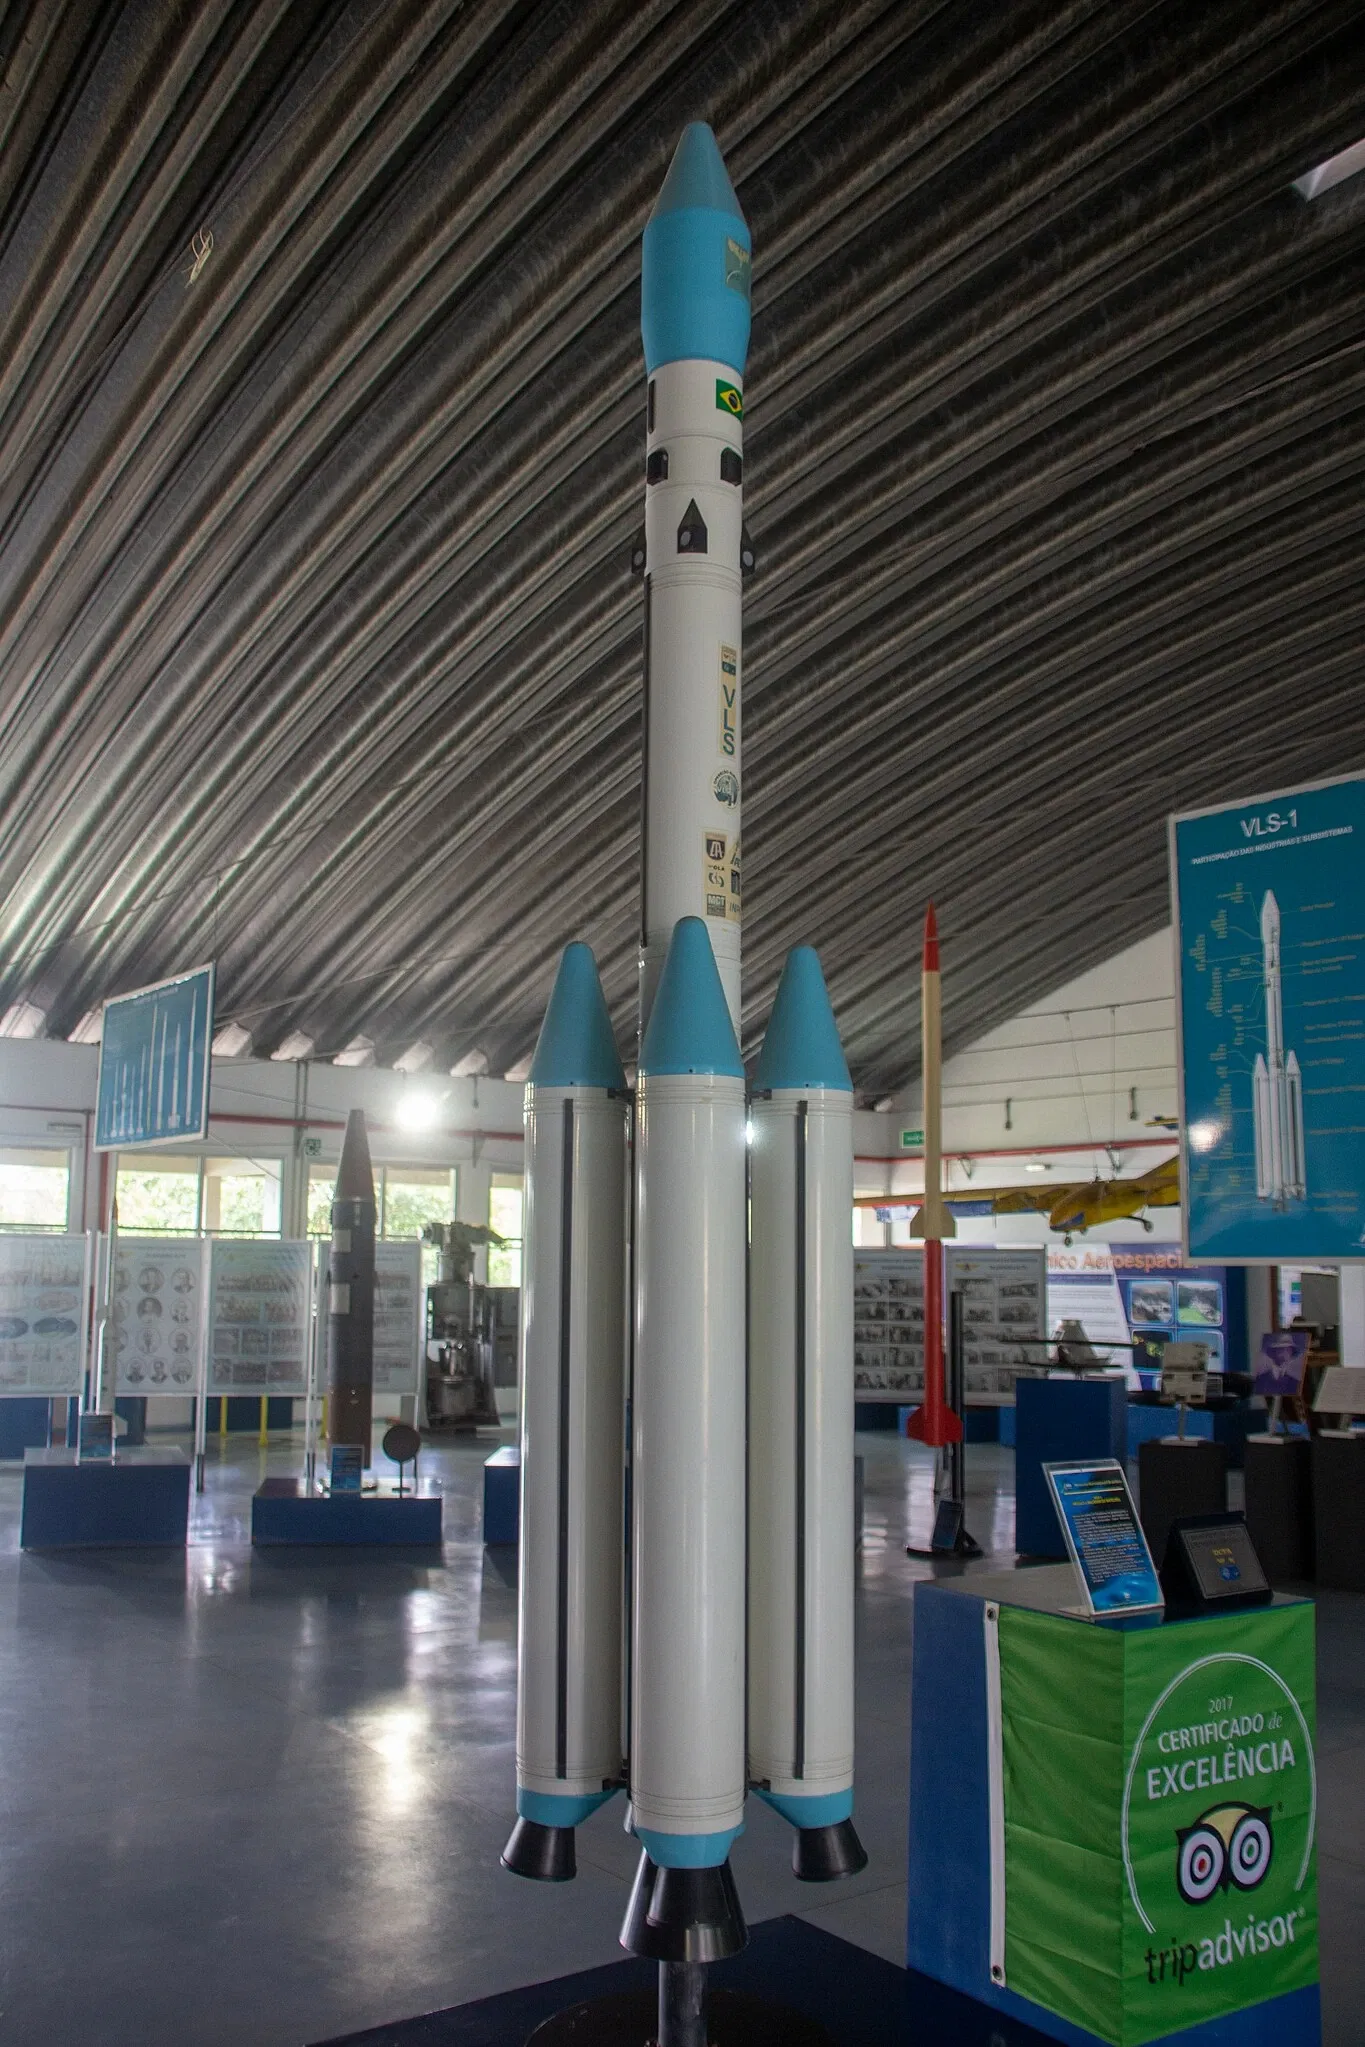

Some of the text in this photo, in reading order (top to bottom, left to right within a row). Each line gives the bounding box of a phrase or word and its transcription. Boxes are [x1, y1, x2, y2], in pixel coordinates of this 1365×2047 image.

[722, 684, 736, 756] VLS
[1240, 808, 1298, 838] VLS-1
[1083, 1249, 1198, 1273] Aeroespaci
[1208, 1696, 1233, 1713] 2017
[1158, 1712, 1282, 1753] CERTIFICADO de
[1147, 1738, 1296, 1800] EXCELÊNCIA
